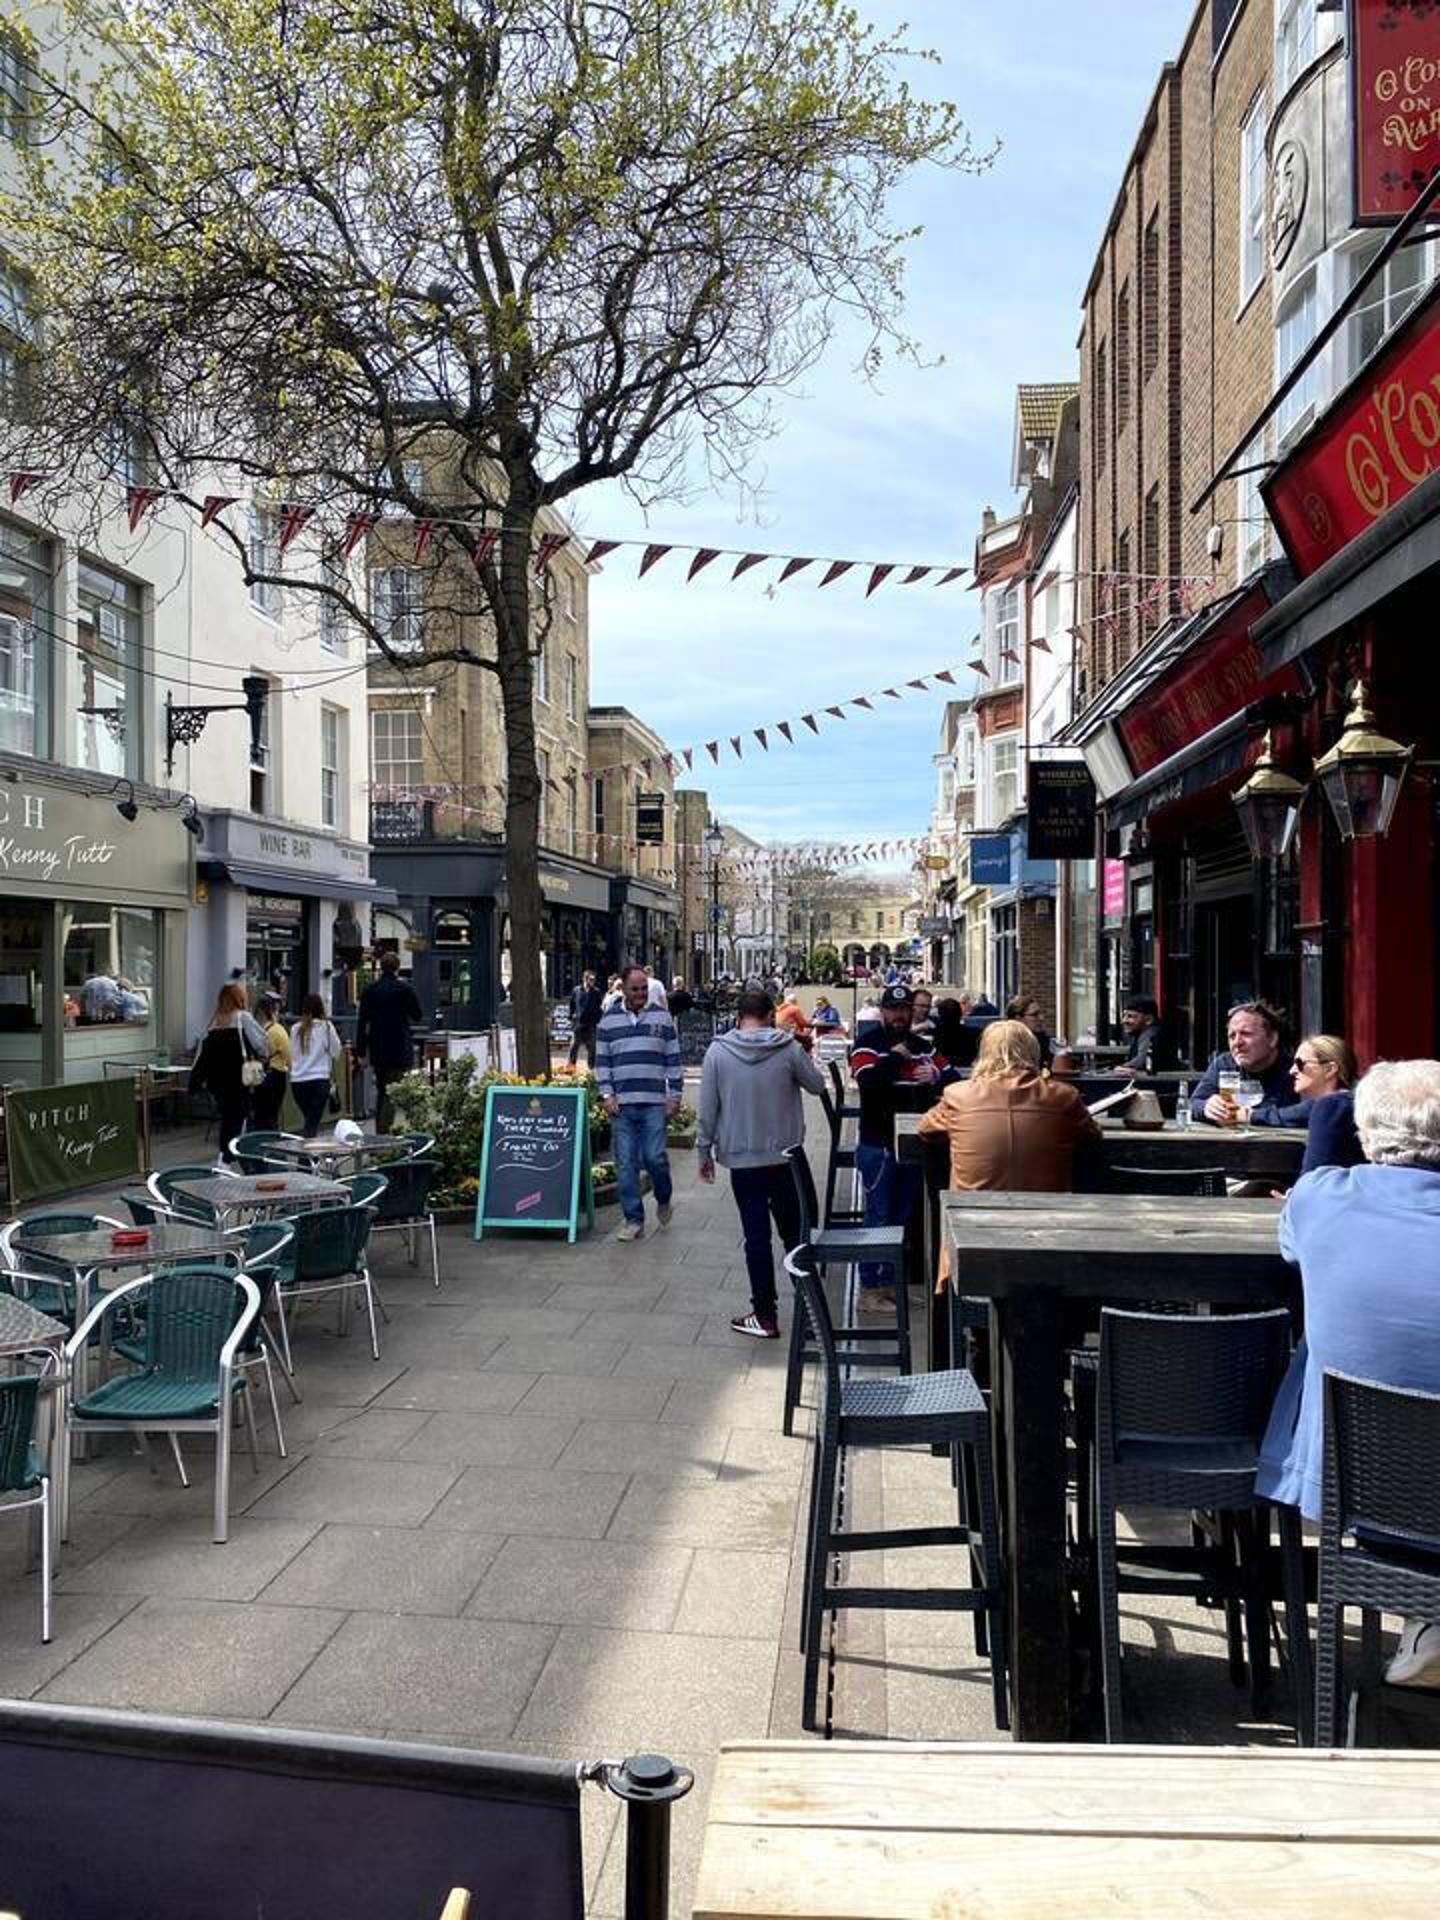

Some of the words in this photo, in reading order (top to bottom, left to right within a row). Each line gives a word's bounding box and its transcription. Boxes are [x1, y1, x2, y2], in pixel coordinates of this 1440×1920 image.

[1400, 98, 1431, 113] ON
[1345, 373, 1440, 517] O'Co
[64, 835, 117, 870] Tutt
[260, 833, 288, 856] WINE
[292, 838, 312, 860] BAR
[29, 1104, 89, 1130] PITCH
